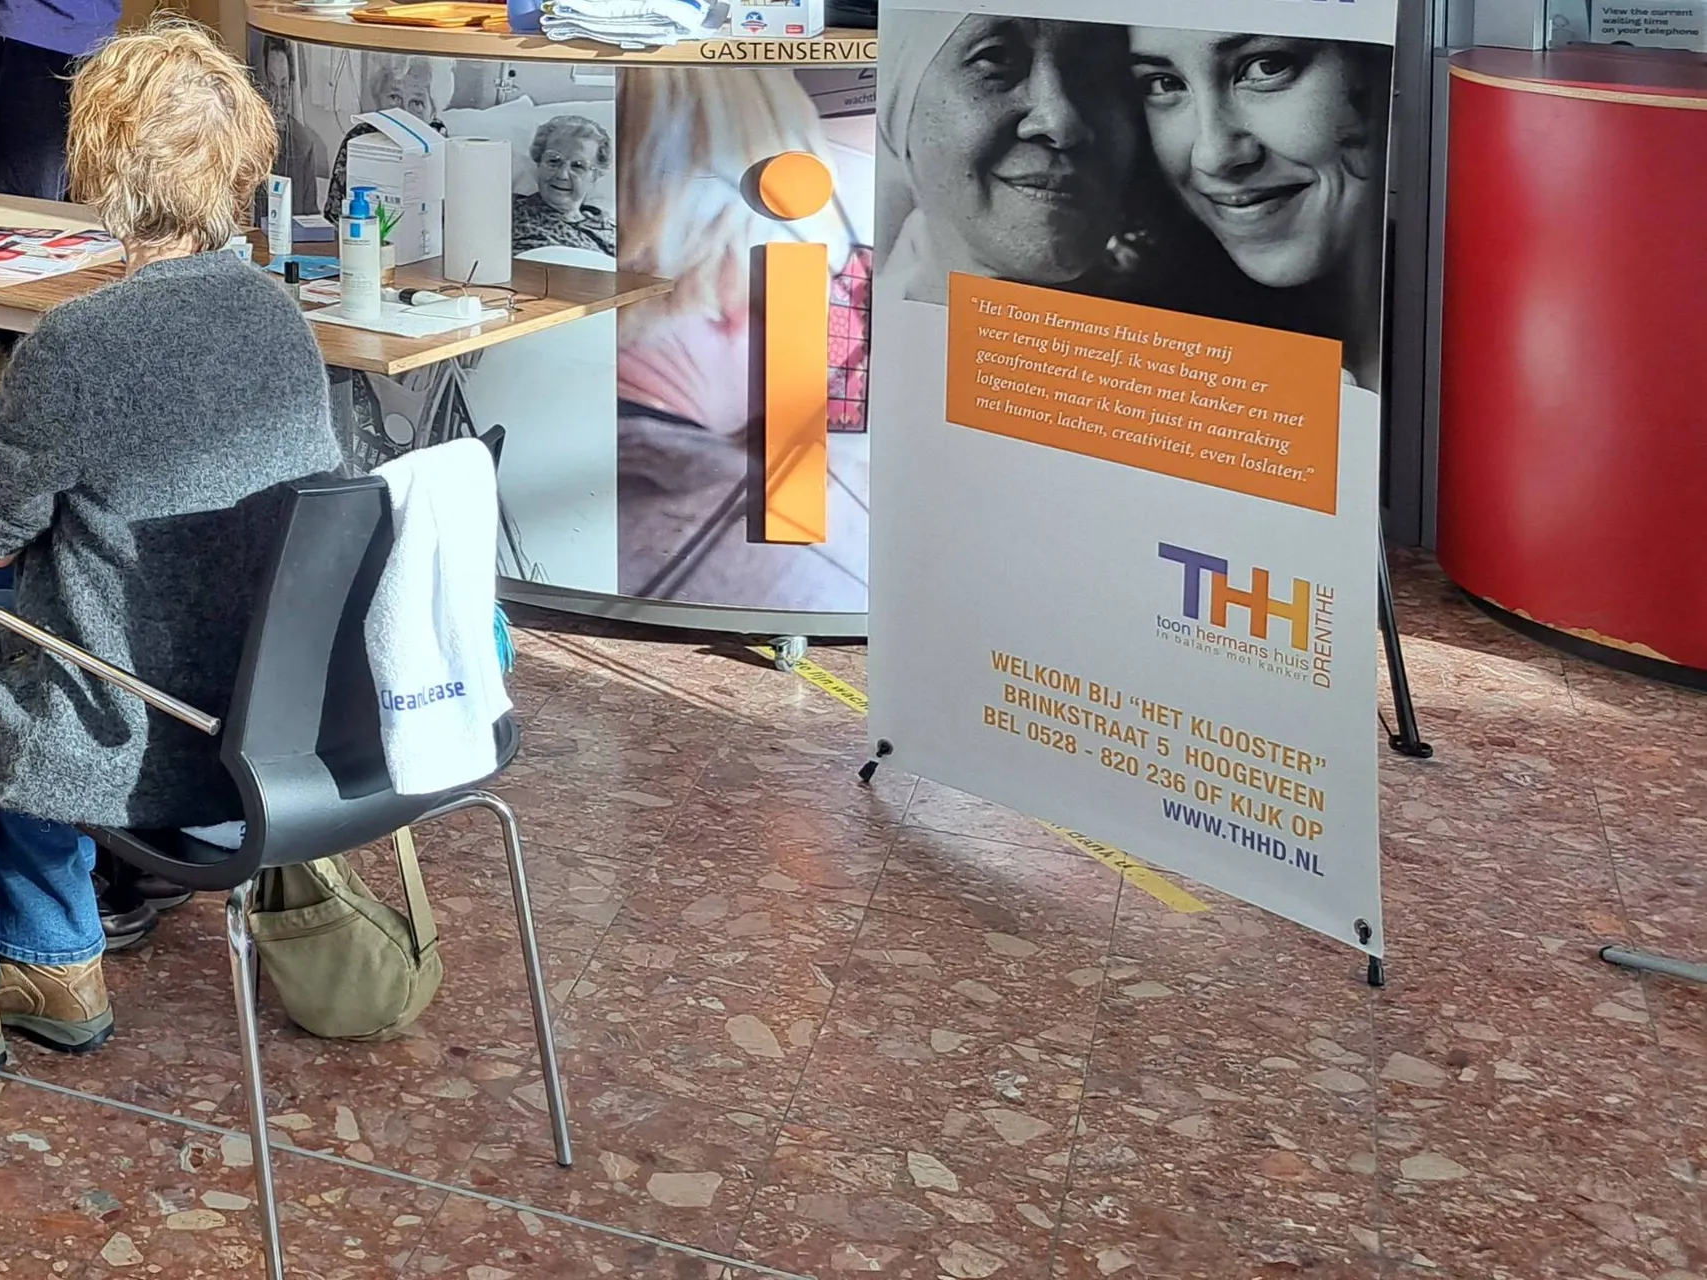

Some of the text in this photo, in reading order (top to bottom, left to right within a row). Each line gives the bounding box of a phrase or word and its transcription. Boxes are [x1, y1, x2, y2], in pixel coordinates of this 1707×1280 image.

[1602, 7, 1628, 15] View
[1603, 17, 1642, 26] waiting
[1644, 28, 1699, 36] telephone
[700, 42, 877, 60] GASTENSERVIC
[978, 325, 1269, 394] weer terug bij mezelf. ik was bang om er
[1007, 304, 1040, 325] Toon
[1044, 311, 1110, 338] Hermans
[1114, 324, 1149, 345] Huis
[1153, 330, 1203, 358] brengt
[1205, 344, 1234, 364] mij
[976, 348, 1305, 428] geconfronteerd te worden met kanker en met
[976, 369, 1291, 455] lotgenoten, maar ik kom juist in aanraking
[976, 394, 1002, 411] met
[1004, 399, 1054, 424] humor,
[1057, 411, 1108, 438] lachen,
[1112, 426, 1195, 459] creativiteit,
[1200, 448, 1237, 466] even
[1157, 541, 1311, 653] THH
[1156, 615, 1309, 671] toon hermans huis
[1175, 633, 1220, 656] balans
[1227, 651, 1252, 666] met
[1258, 660, 1308, 682] kanker
[1312, 583, 1335, 689] DRENTHE
[990, 650, 1082, 698] WELKOM
[1088, 682, 1124, 711] BIJ
[1190, 714, 1328, 776] KLOOSTER”
[1003, 682, 1326, 813] BRINKSTRAAT 5 HOOGEVEEN
[983, 705, 1021, 735] BEL
[1027, 720, 1078, 756] 0528
[1100, 745, 1139, 778] 820
[1145, 762, 1186, 795] 236
[1194, 778, 1224, 807] OF
[1230, 789, 1283, 829] KIJK
[1290, 814, 1324, 841] OP
[1161, 797, 1325, 878] WWW.THHD.NL
